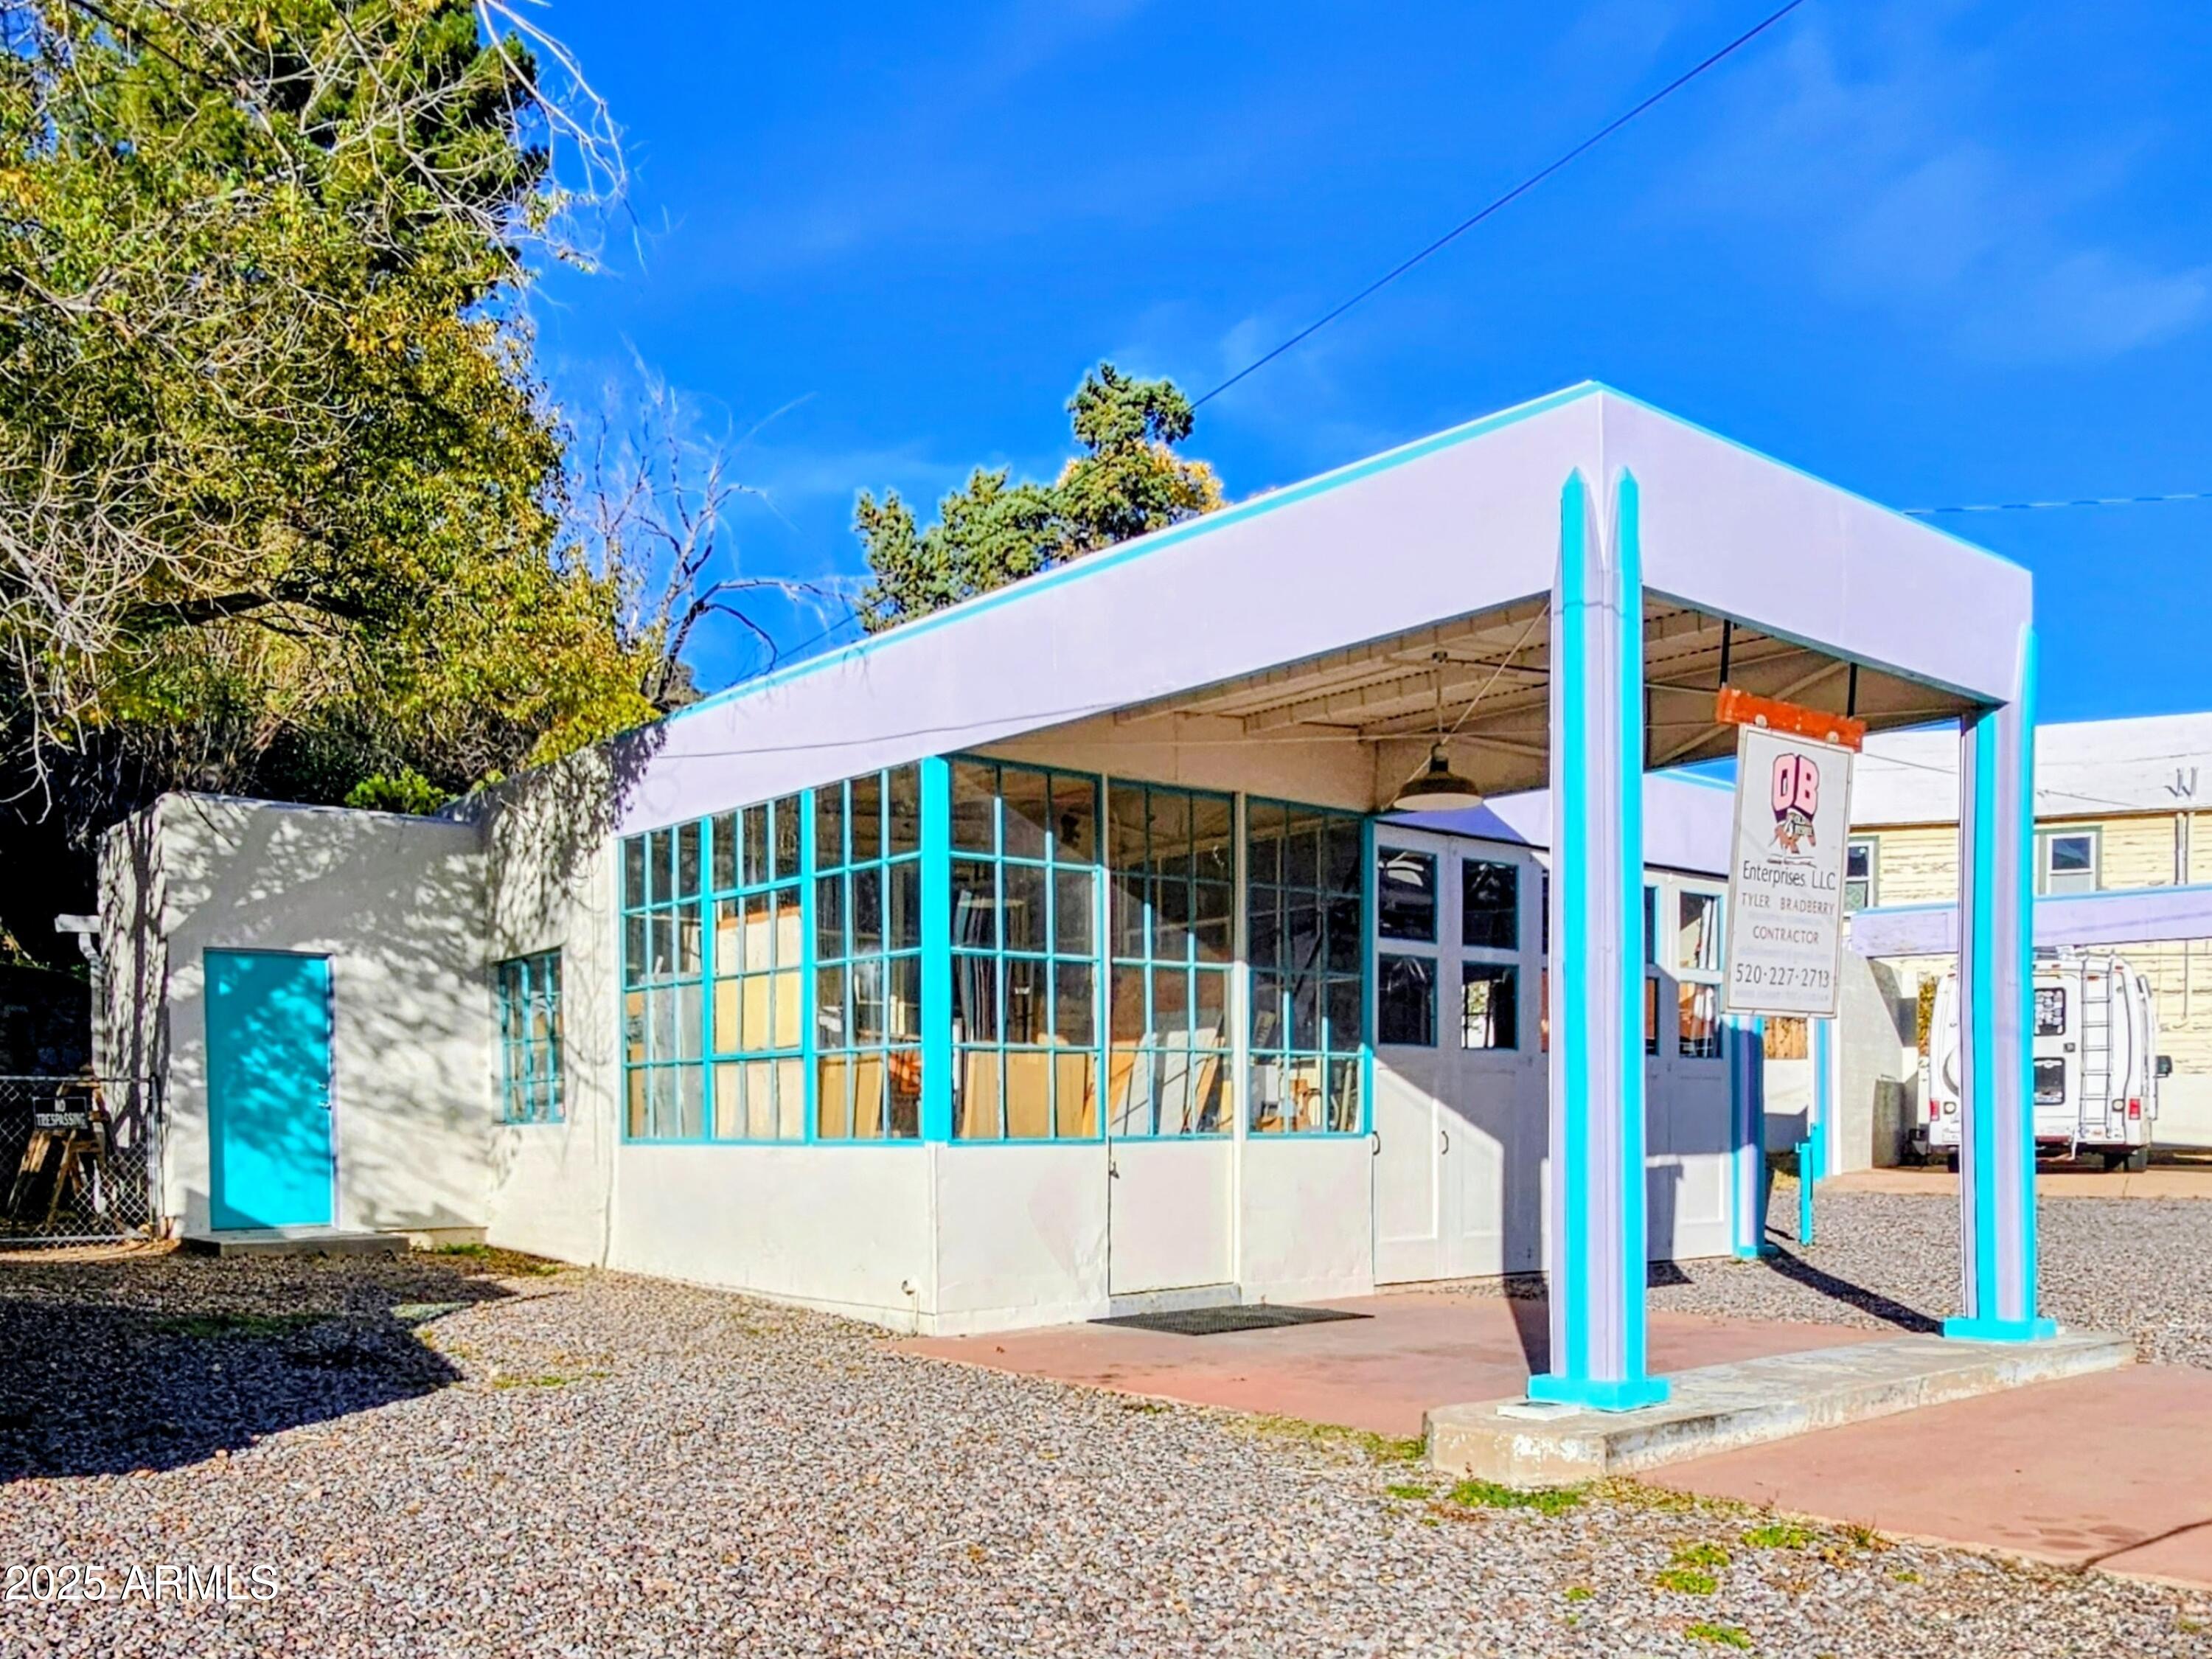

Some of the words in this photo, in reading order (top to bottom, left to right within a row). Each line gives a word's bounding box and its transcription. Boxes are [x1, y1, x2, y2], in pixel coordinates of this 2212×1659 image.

[1743, 860, 1805, 888] Enterprises
[1812, 871, 1836, 890] LLC
[1742, 892, 1770, 908] TYLER
[1781, 897, 1834, 915] BRADBERRY
[1753, 925, 1819, 944] CONTRACTOR
[55, 1099, 66, 1112] NO
[36, 1113, 86, 1127] TRESPASSING
